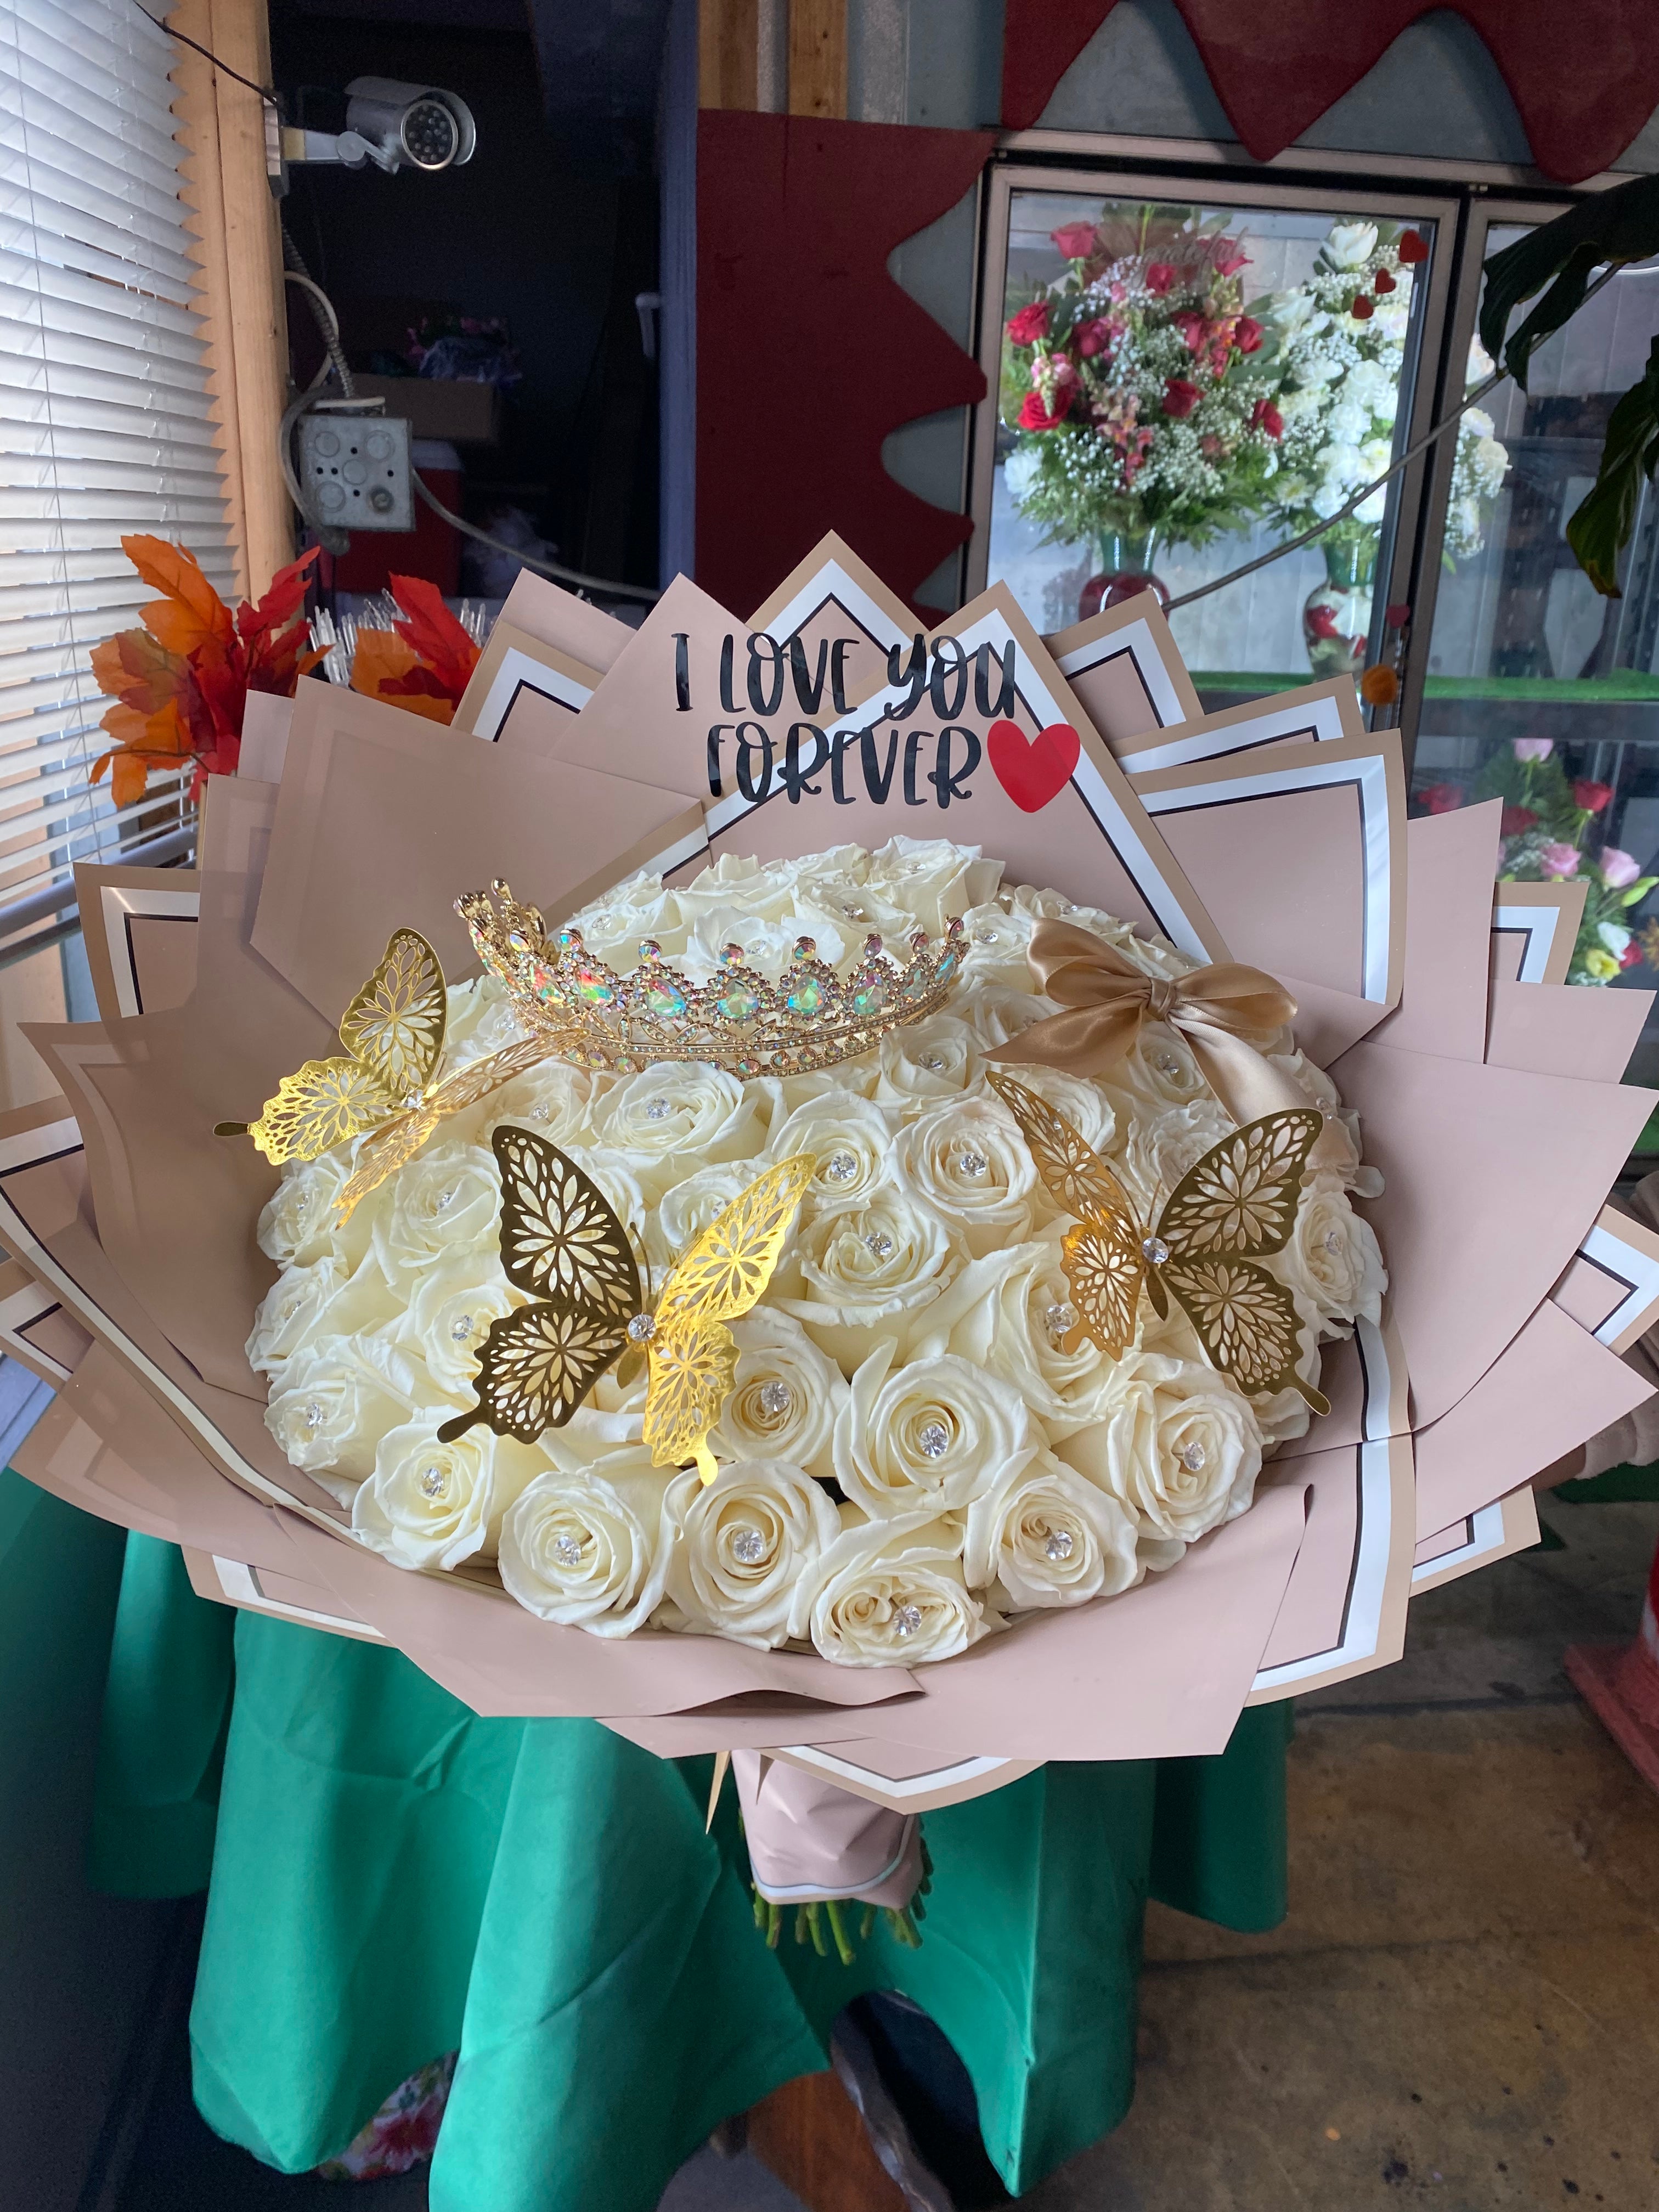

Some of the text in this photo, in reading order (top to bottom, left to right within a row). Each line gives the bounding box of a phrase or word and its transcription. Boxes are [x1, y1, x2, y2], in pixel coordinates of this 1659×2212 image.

[671, 633, 693, 712] I
[719, 632, 860, 716] LOVE
[706, 721, 982, 809] FOREVER
